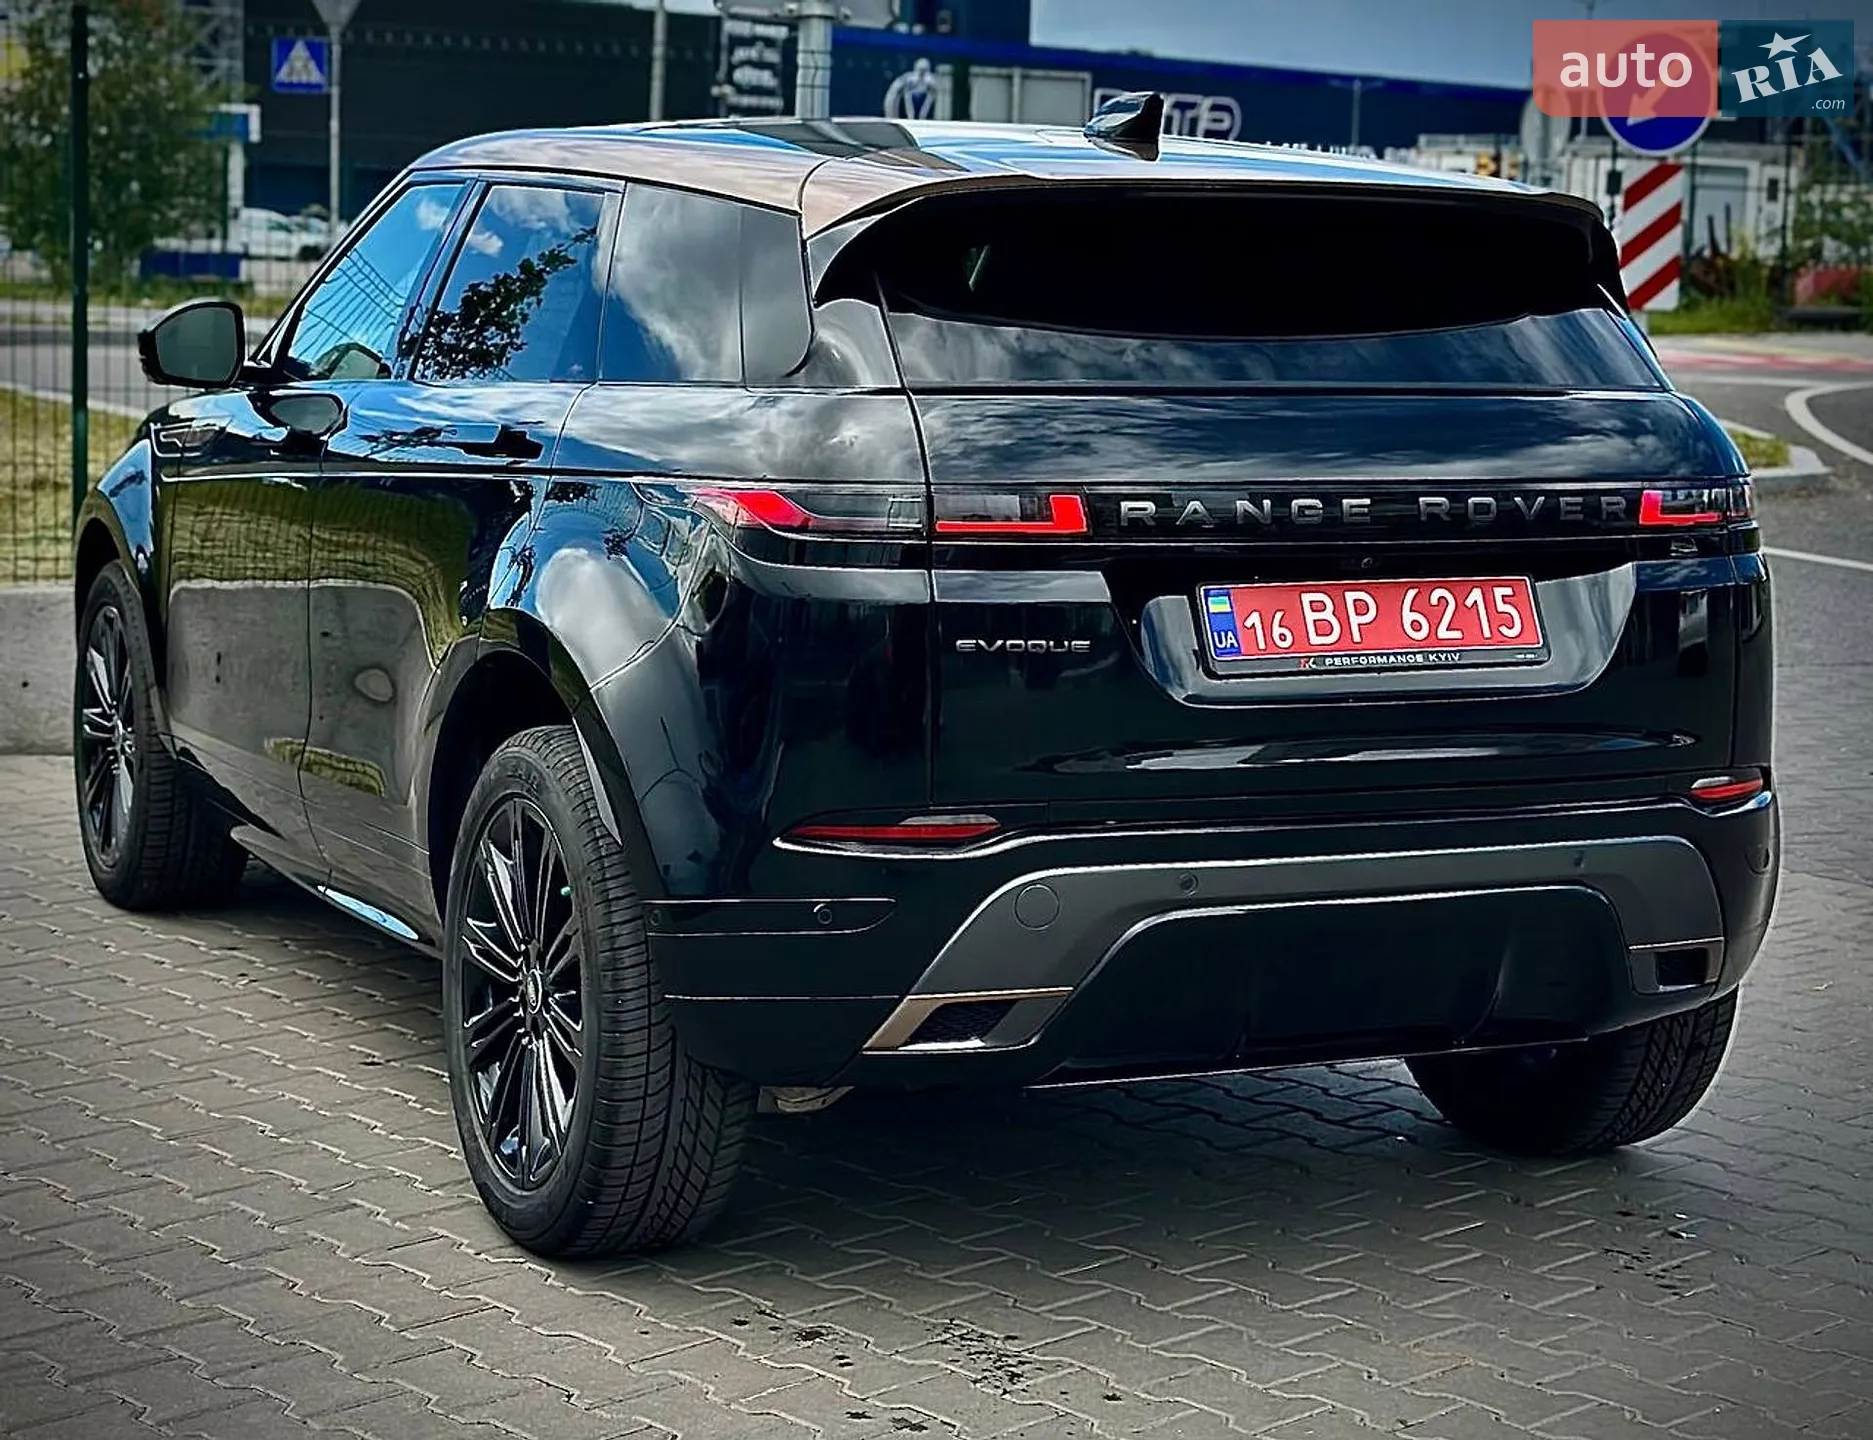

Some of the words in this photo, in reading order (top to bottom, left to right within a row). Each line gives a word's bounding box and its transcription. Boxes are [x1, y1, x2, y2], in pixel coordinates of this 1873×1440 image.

[1119, 497, 1372, 528] RANGE
[1418, 495, 1628, 522] ROVER
[1243, 610, 1294, 650] 16
[1300, 590, 1379, 646] BP
[1401, 586, 1523, 642] 6215
[955, 639, 1091, 654] EVOQUE
[1213, 630, 1239, 649] UA
[1324, 653, 1424, 667] PERFORMANCE
[1428, 652, 1460, 663] KYIV
